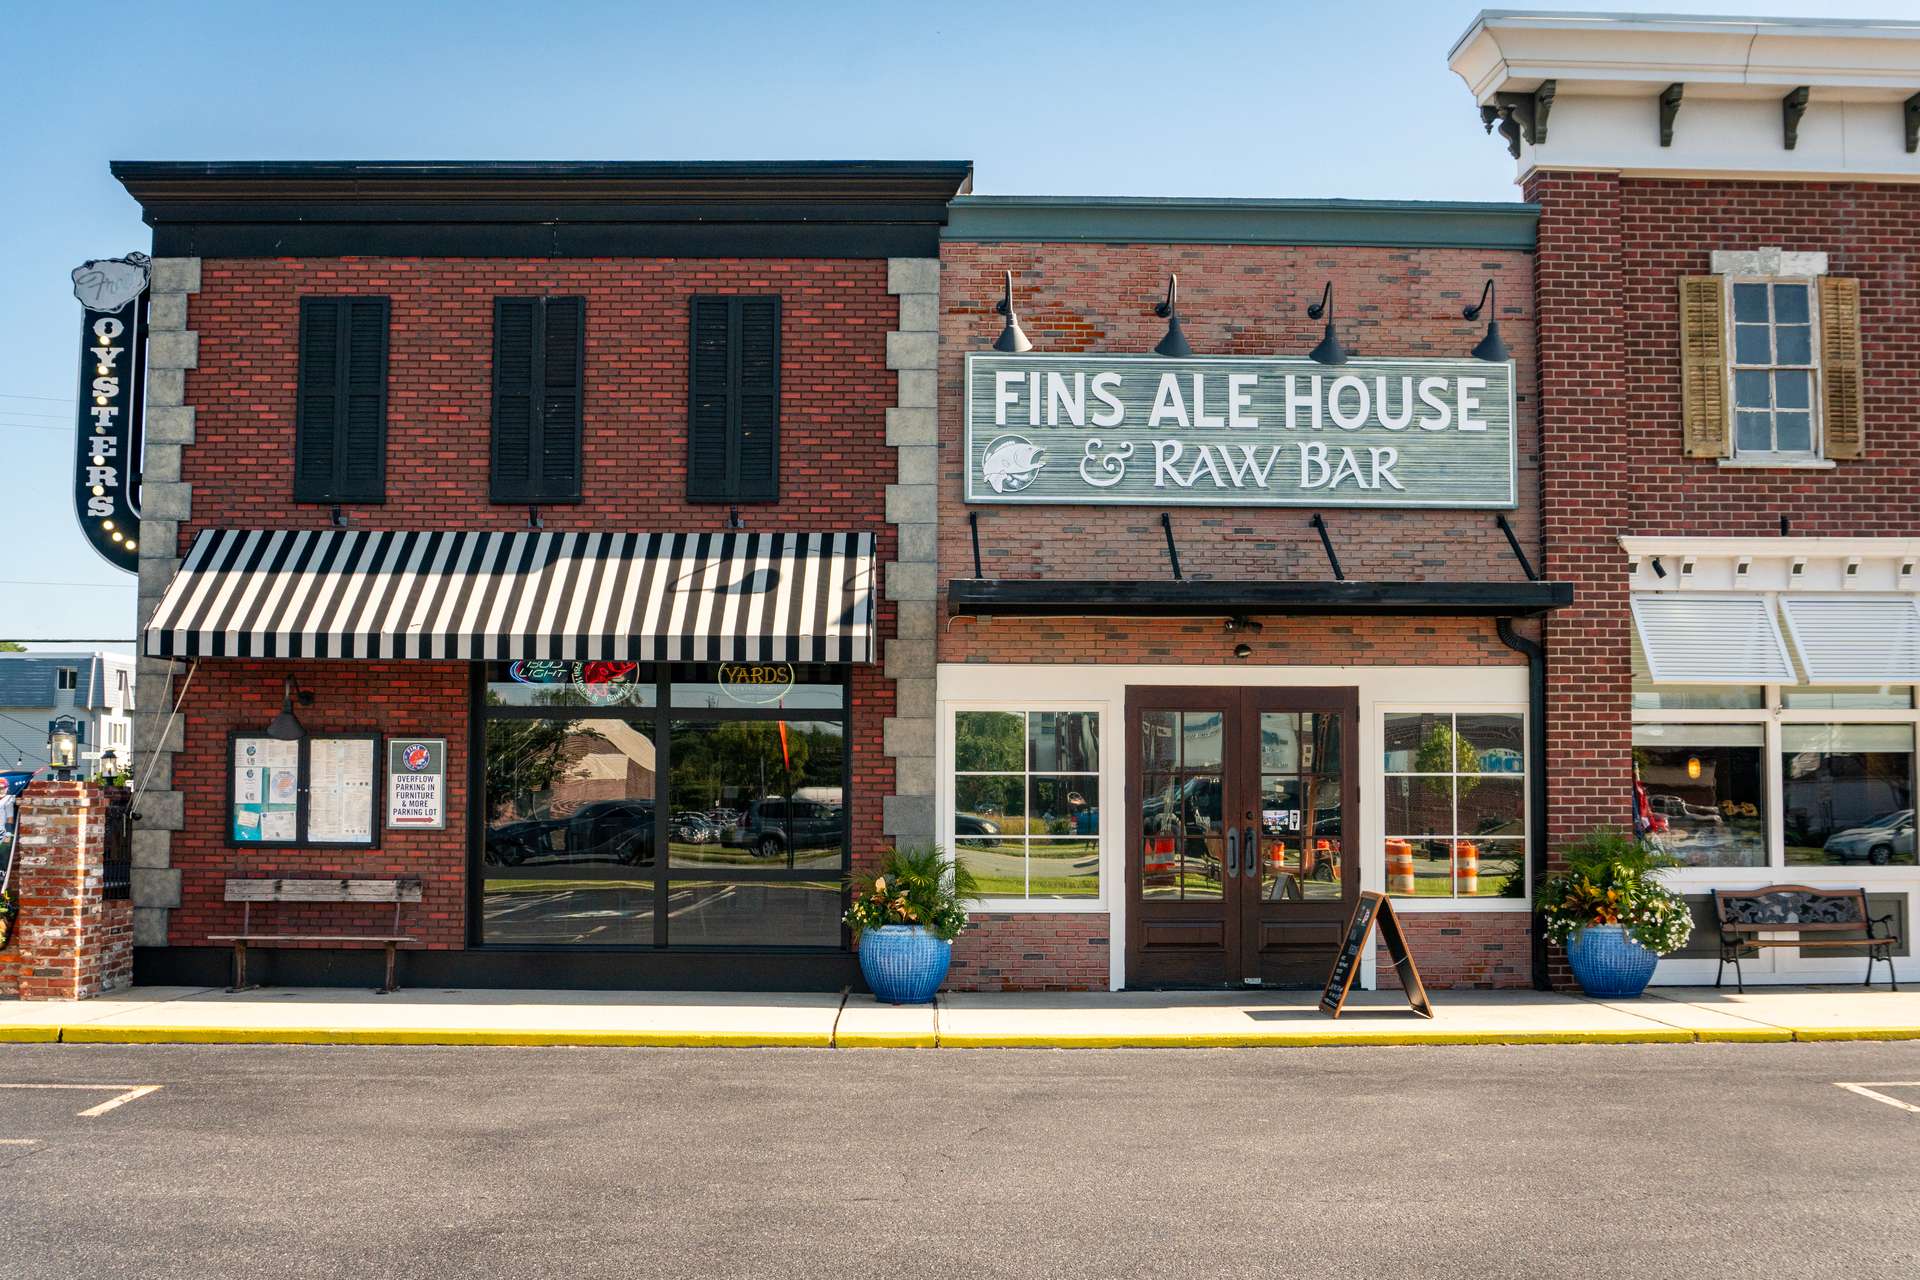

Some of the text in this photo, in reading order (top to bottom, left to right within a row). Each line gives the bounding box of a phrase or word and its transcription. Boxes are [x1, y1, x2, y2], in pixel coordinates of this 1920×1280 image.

[995, 371, 1488, 431] FINS ALE HOUSE
[86, 317, 125, 517] OYSTERS
[1079, 437, 1406, 490] & RAW BAR
[527, 661, 564, 669] BUD
[518, 668, 568, 678] LIGHT
[724, 666, 789, 684] YARDS
[397, 775, 434, 783] OVERFLOW
[395, 783, 426, 791] PARKING
[396, 791, 434, 799] FURNITURE
[401, 800, 407, 808] &
[393, 808, 437, 816] PARKING LOT
